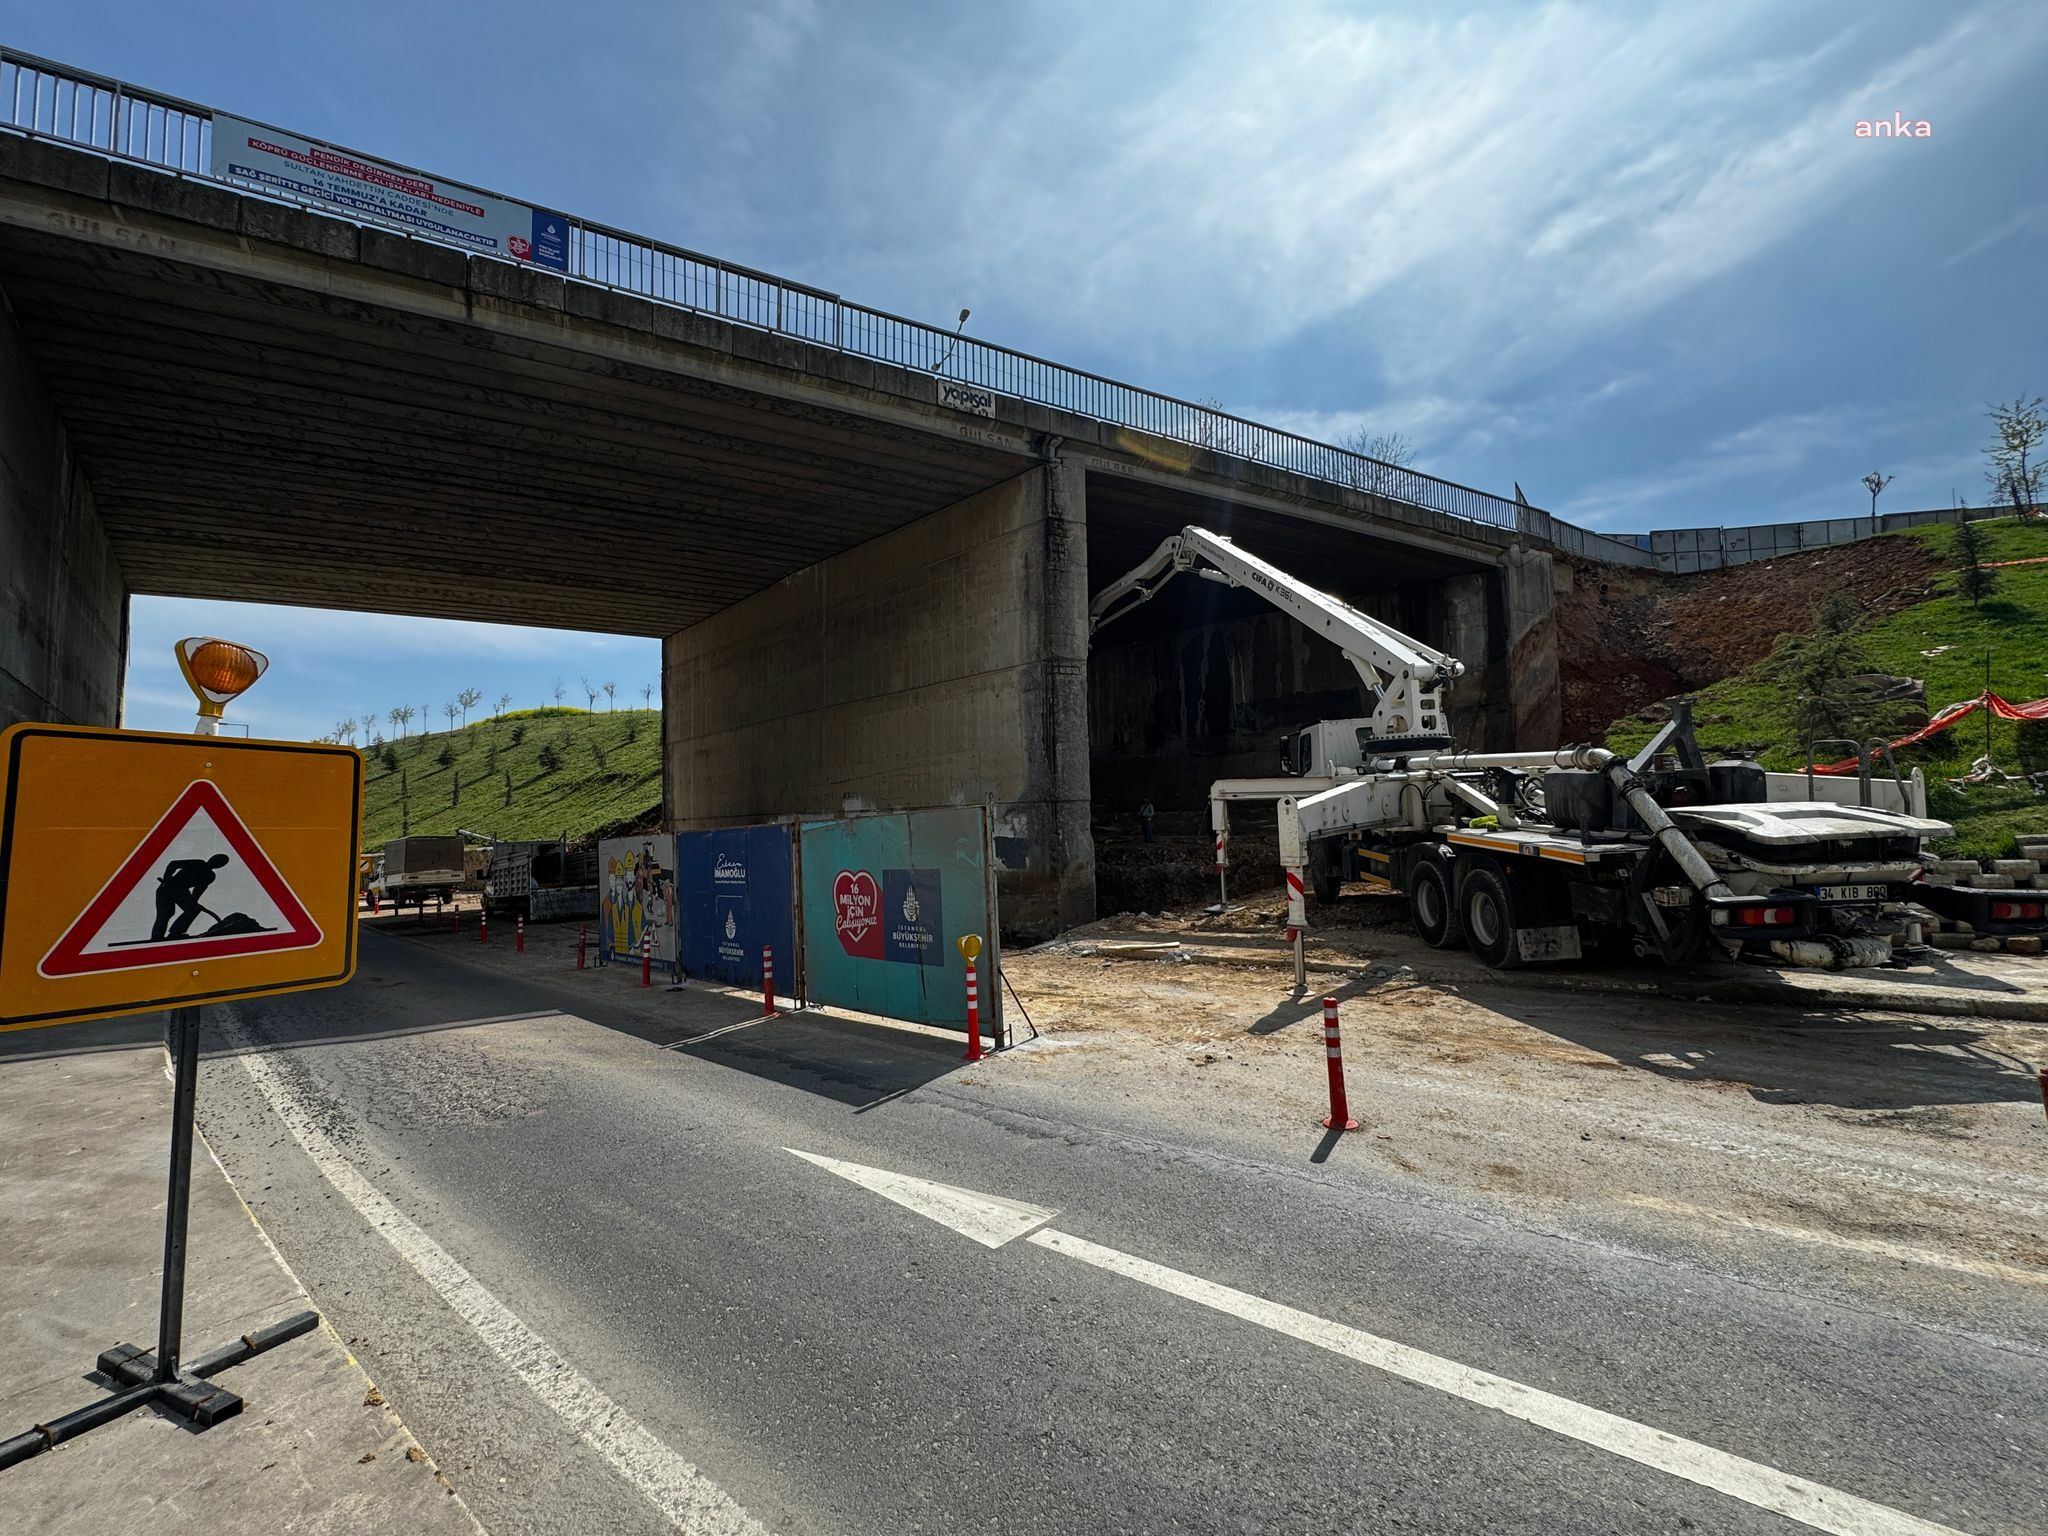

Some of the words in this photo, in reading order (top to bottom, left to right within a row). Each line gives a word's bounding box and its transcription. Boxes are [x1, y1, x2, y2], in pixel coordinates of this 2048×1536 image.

[252, 140, 288, 156] KÖPRÜ
[291, 151, 364, 179] GÜÇLENDİRME
[366, 174, 429, 199] ÇALIŞMALARI
[431, 195, 481, 215] NEDENİYLE
[313, 150, 350, 167] PENDİK
[352, 161, 403, 184] DEĞİRMEN
[405, 179, 431, 191] DERE
[283, 160, 325, 178] SULTAN
[327, 174, 385, 195] VAHDETTİN
[387, 190, 454, 216] CADDESİ'NDE
[312, 178, 324, 187] 16
[326, 183, 388, 206] TEMMUZ'A
[389, 198, 428, 217] KADAR
[234, 166, 257, 178] SAĞ
[258, 173, 299, 191] ŞERİTTE
[300, 185, 334, 200] GEÇİCİ
[335, 195, 356, 206] YOL
[355, 201, 415, 224] DARALTMASI
[416, 219, 495, 247] UYGULANACAKTIR
[1251, 572, 1267, 587] CIFA
[839, 894, 871, 906] MİLYON
[850, 883, 859, 894] 16
[1821, 888, 1834, 900] 34
[1841, 886, 1859, 899] KIB
[892, 931, 933, 943] BÜYÜKŞEHİR
